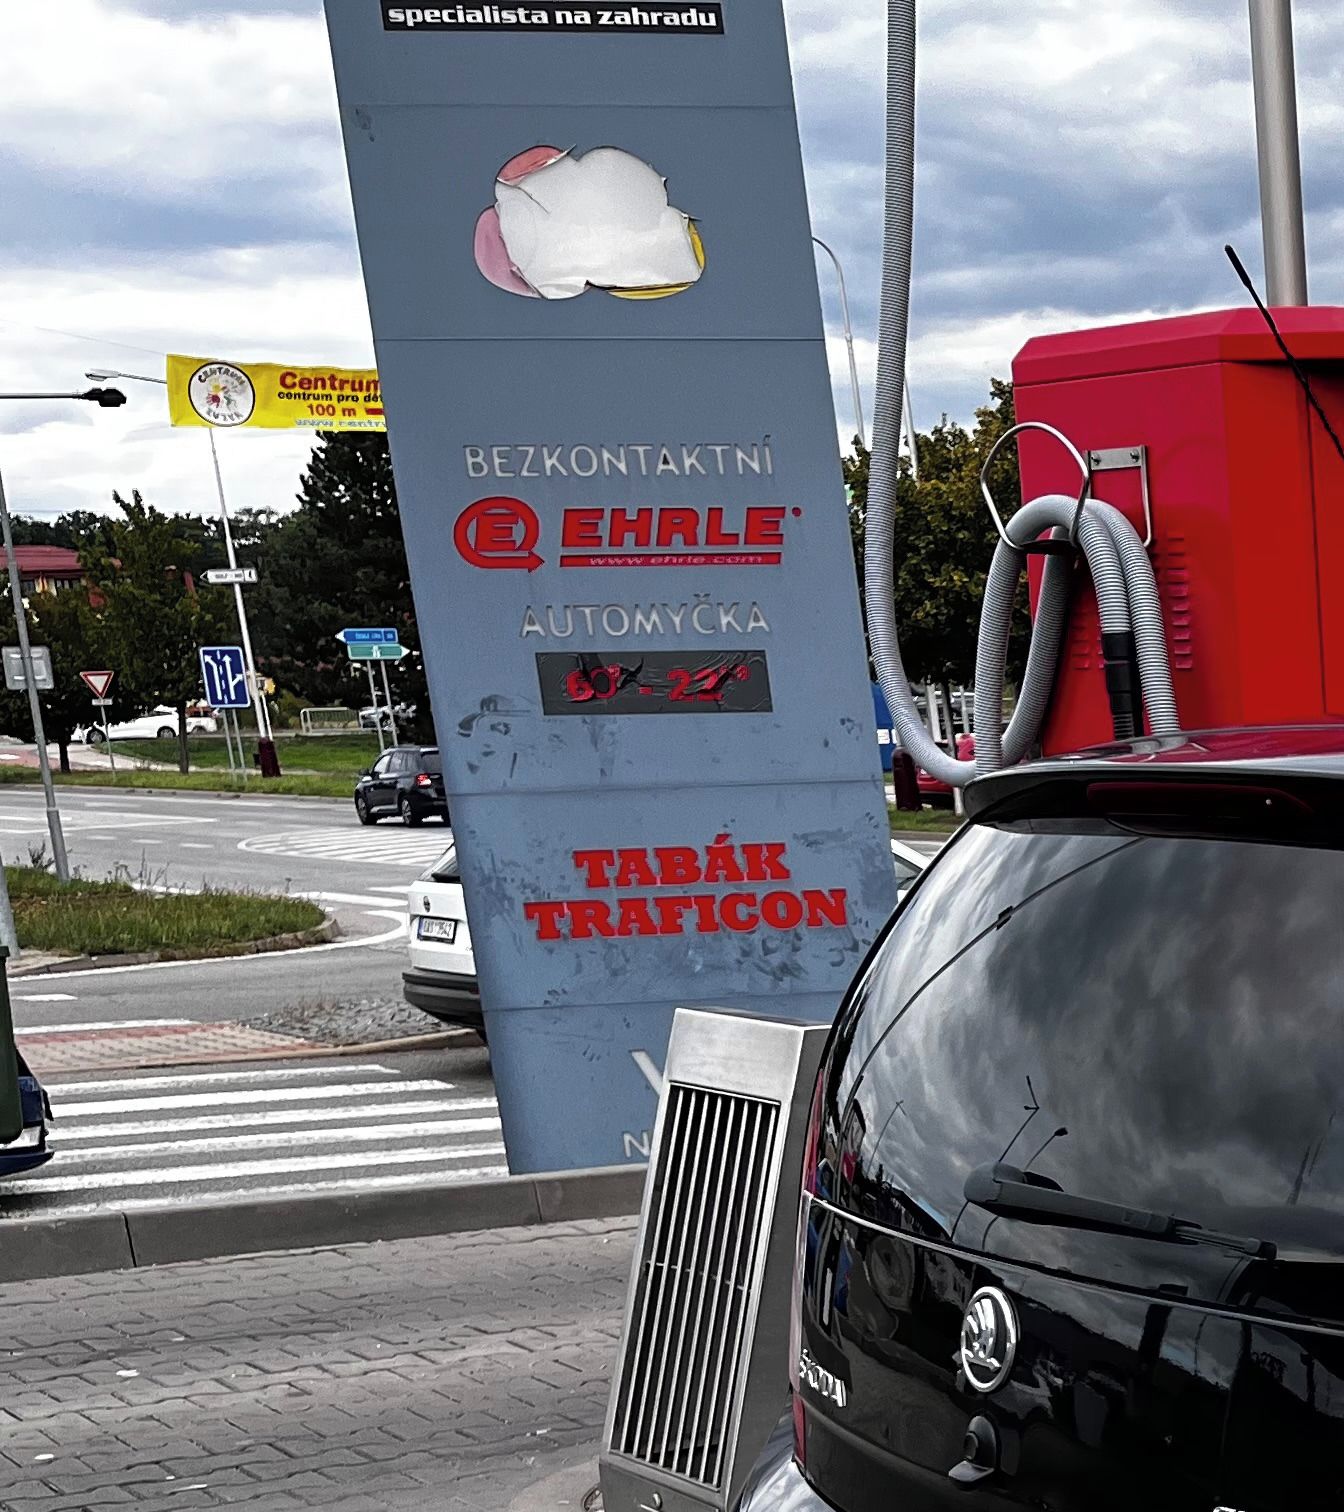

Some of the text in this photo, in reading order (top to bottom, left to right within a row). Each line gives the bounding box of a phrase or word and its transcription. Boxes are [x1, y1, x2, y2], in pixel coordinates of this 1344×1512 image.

[389, 5, 717, 26] specialista na zahradu
[277, 392, 332, 402] centrum
[337, 393, 359, 404] pro
[307, 404, 356, 417] 100 m
[463, 434, 773, 478] BEZKONTAKTNÍ
[561, 507, 786, 547] EHRLE
[521, 593, 770, 638] AUTOMYČKA
[573, 833, 791, 888] TABÁK
[524, 889, 847, 940] TRAFICON
